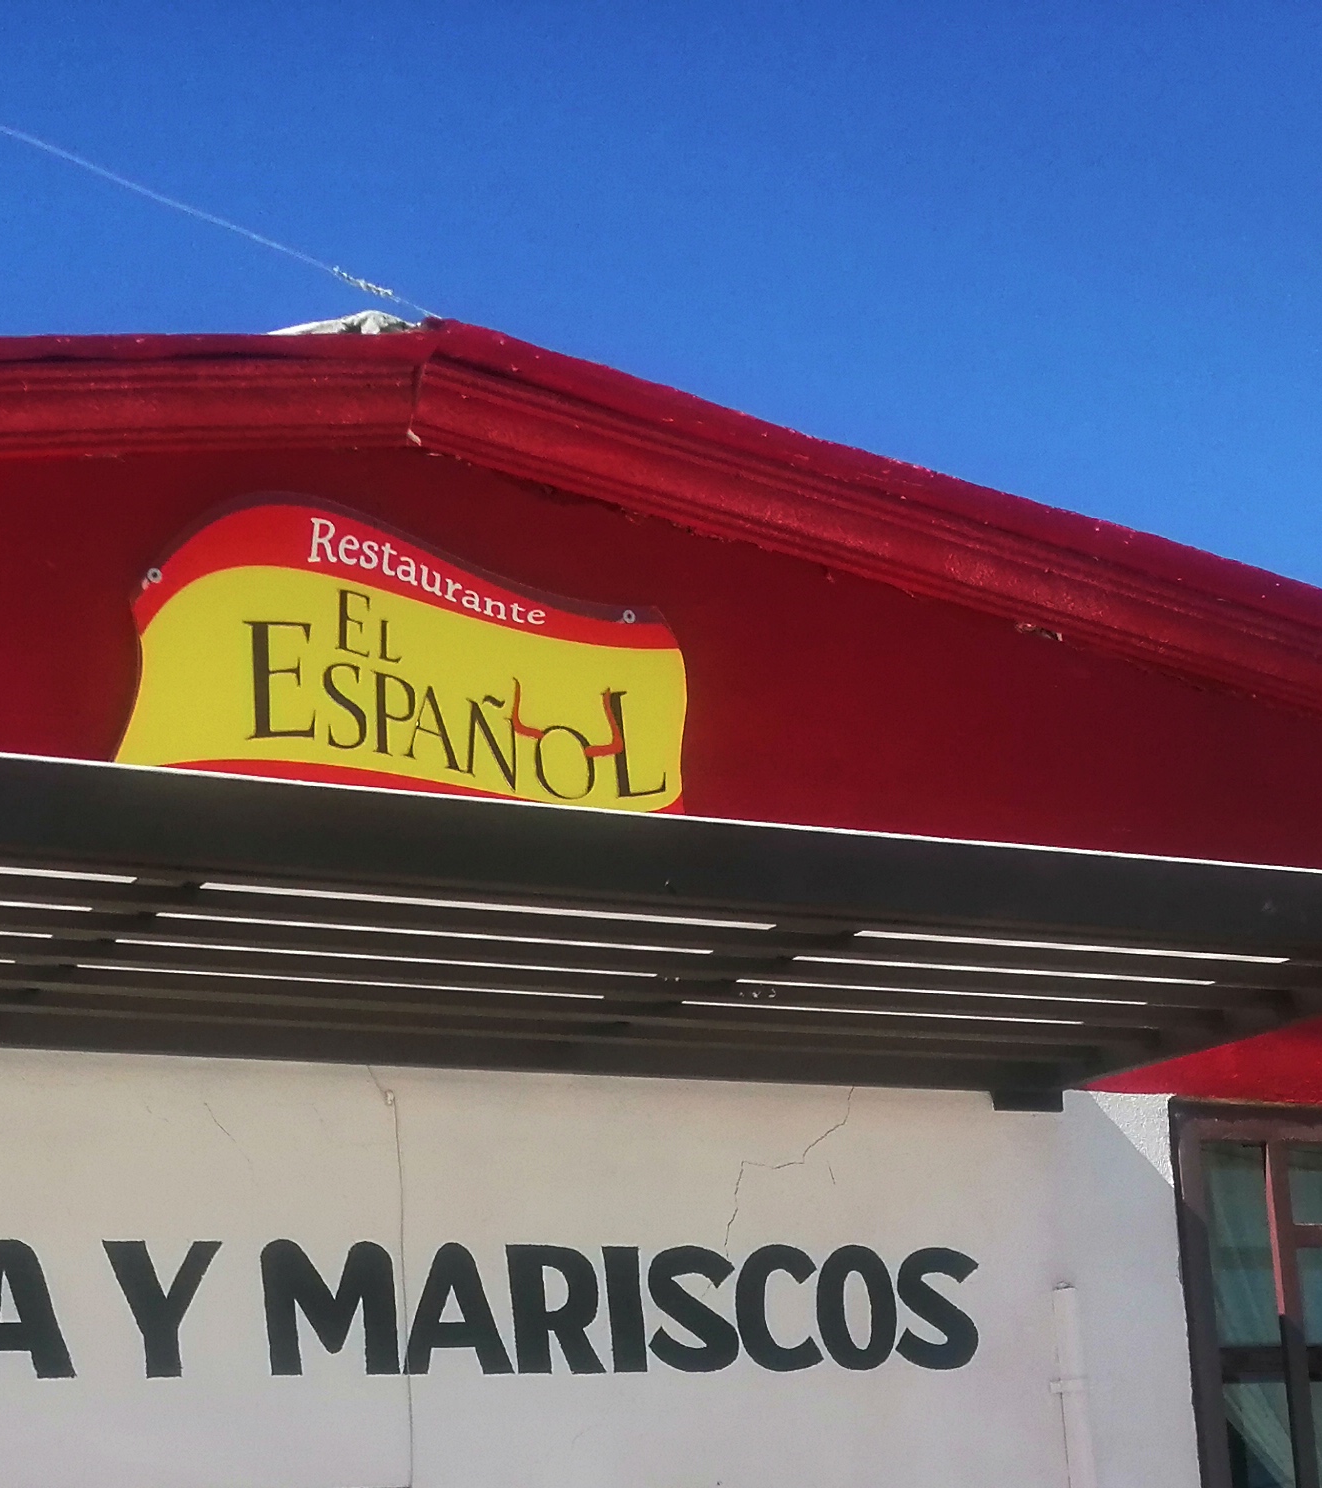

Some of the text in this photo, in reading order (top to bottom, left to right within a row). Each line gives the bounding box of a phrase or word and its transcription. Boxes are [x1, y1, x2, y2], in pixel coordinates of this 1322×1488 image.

[307, 518, 546, 626] Restaurante
[335, 589, 401, 662] EL
[243, 621, 666, 800] ESPAÑOL
[102, 1240, 222, 1378] Y
[260, 1238, 979, 1375] MARISCOS
